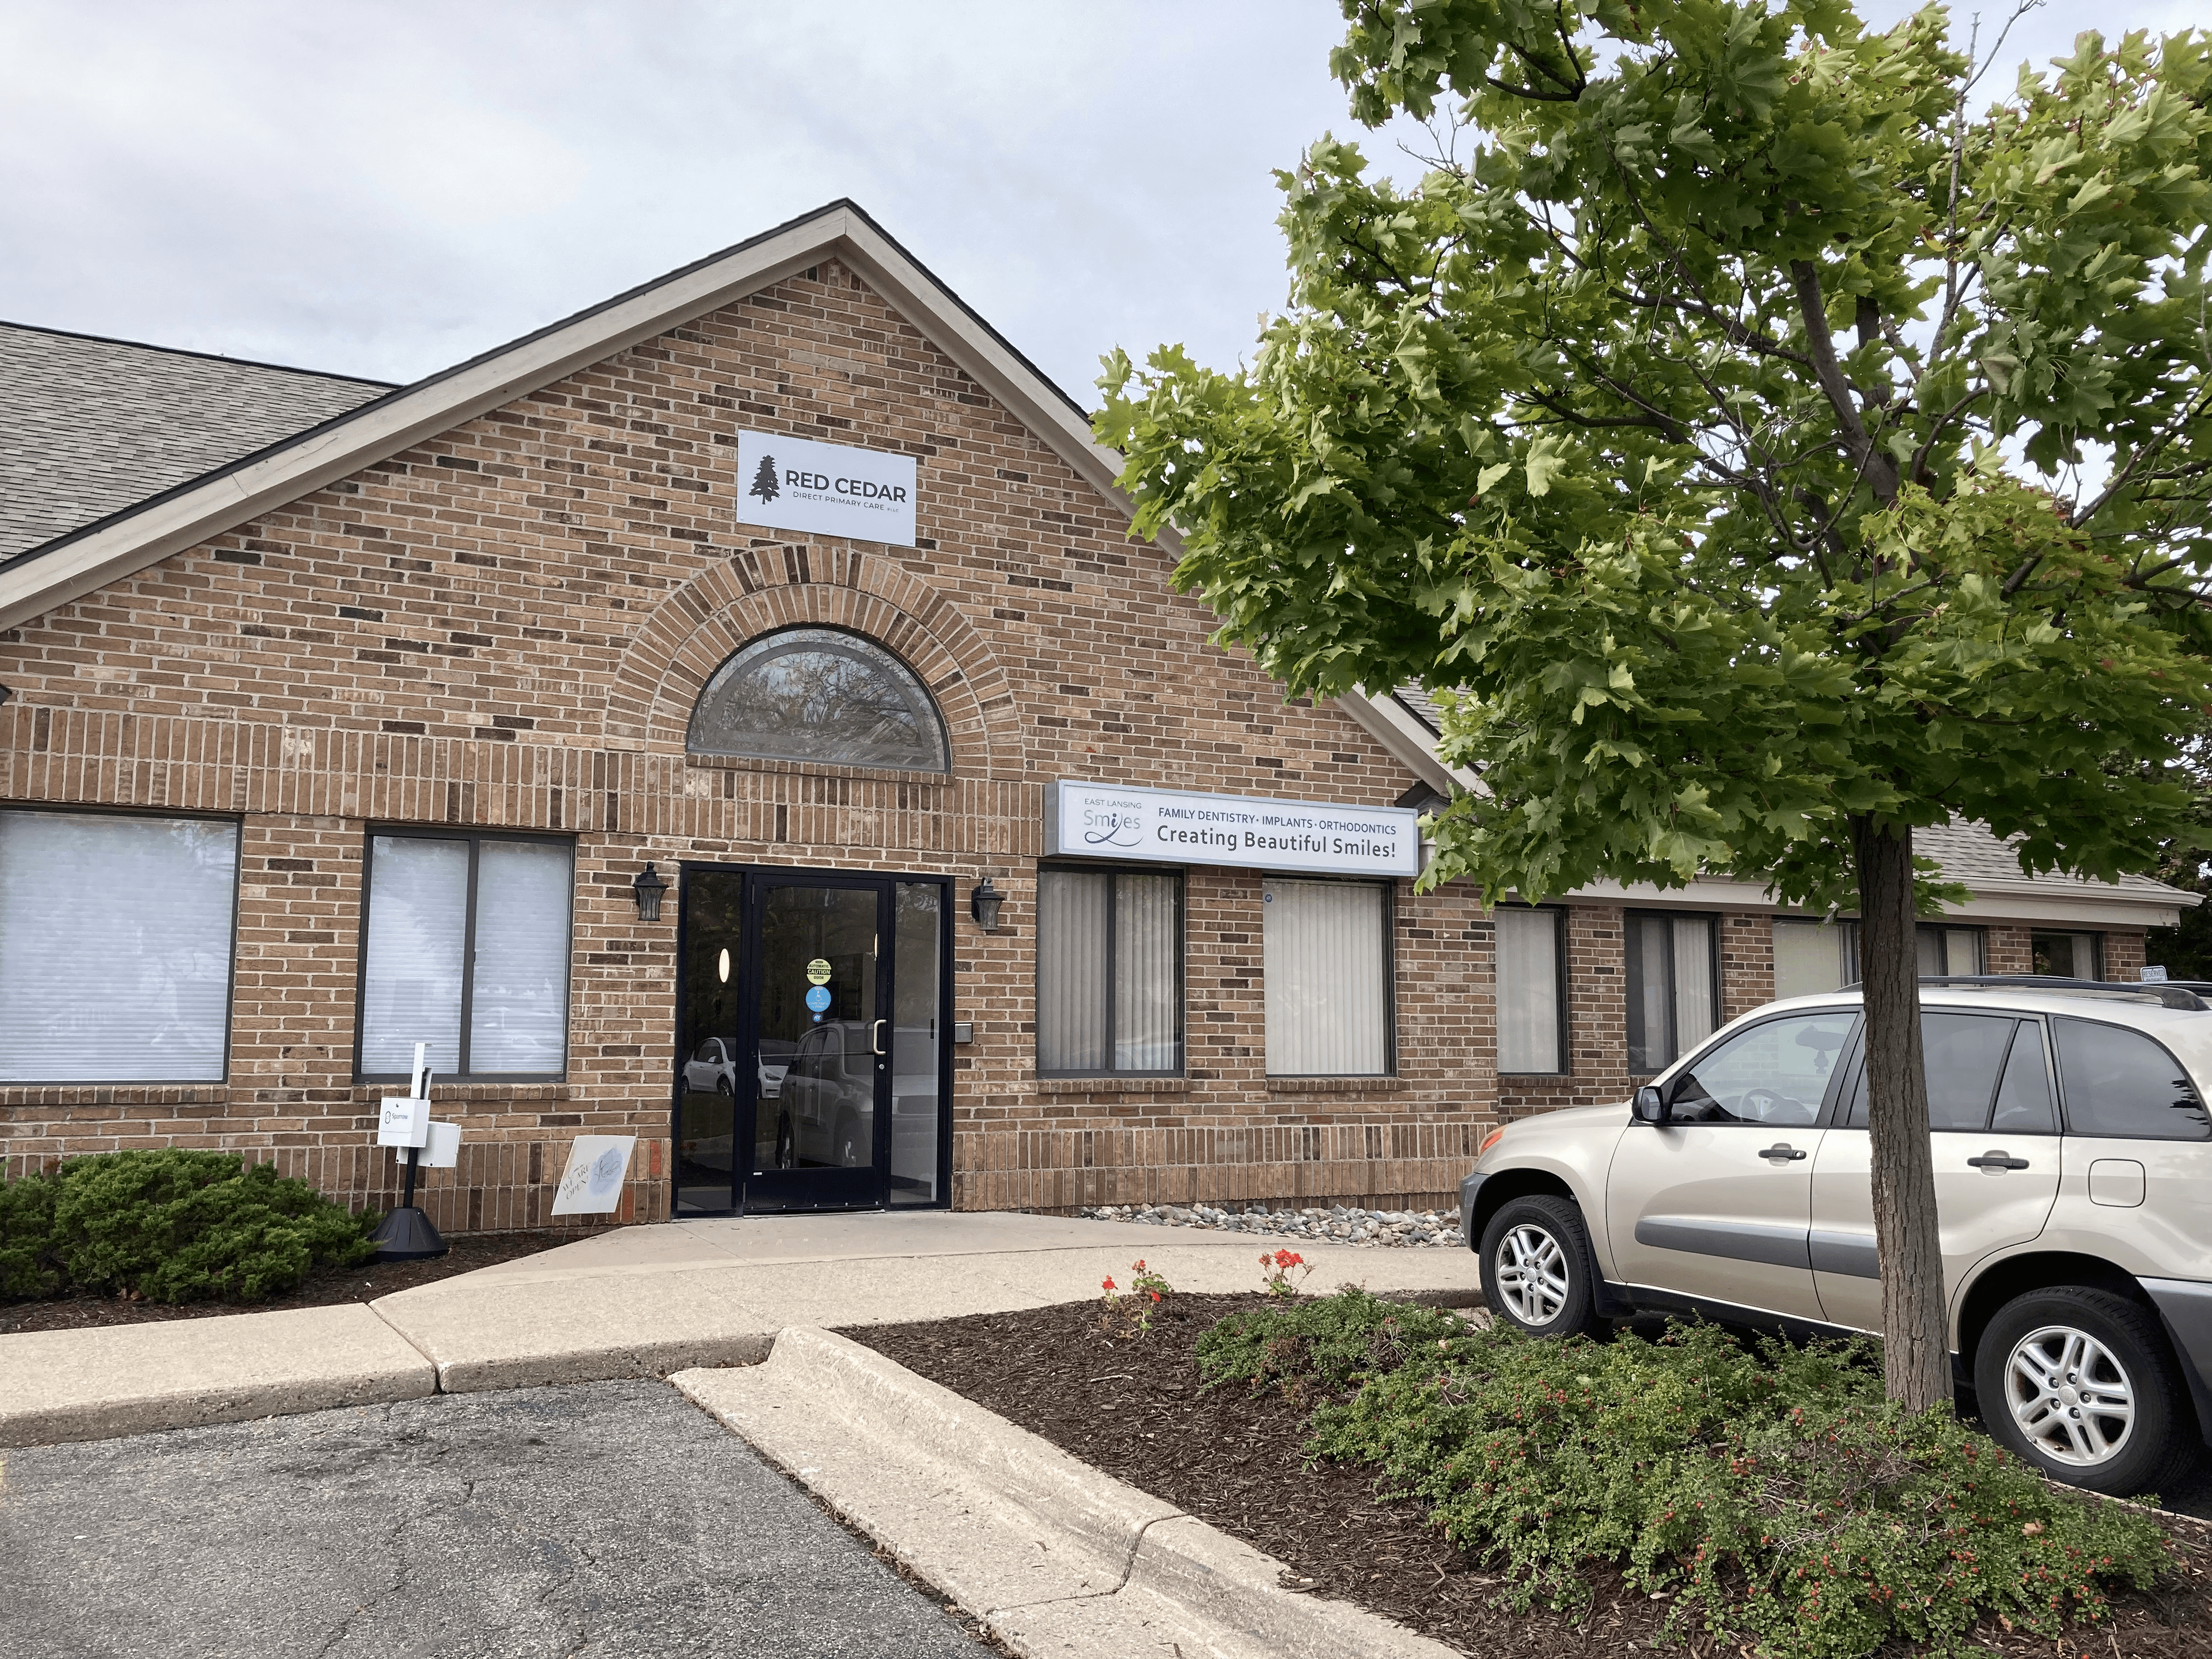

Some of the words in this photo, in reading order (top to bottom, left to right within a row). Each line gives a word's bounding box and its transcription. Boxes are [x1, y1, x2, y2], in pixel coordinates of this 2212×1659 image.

[786, 469, 830, 490] RED
[835, 478, 906, 503] CEDAR
[793, 491, 823, 501] DIRECT
[825, 496, 861, 507] PRIMARY
[863, 502, 884, 510] CARE
[1107, 800, 1142, 809] LANSING
[1084, 809, 1143, 843] Smiles
[1158, 807, 1195, 819] FAMILY
[1198, 810, 1255, 824] DENTISTRY
[1262, 816, 1313, 828] IMPLANTS
[1319, 820, 1396, 835] ORTHODONTICS
[1157, 825, 1237, 851] Creating
[1245, 831, 1326, 853] Beautiful
[1333, 838, 1395, 858] Smiles!
[2143, 969, 2164, 978] RESERVED
